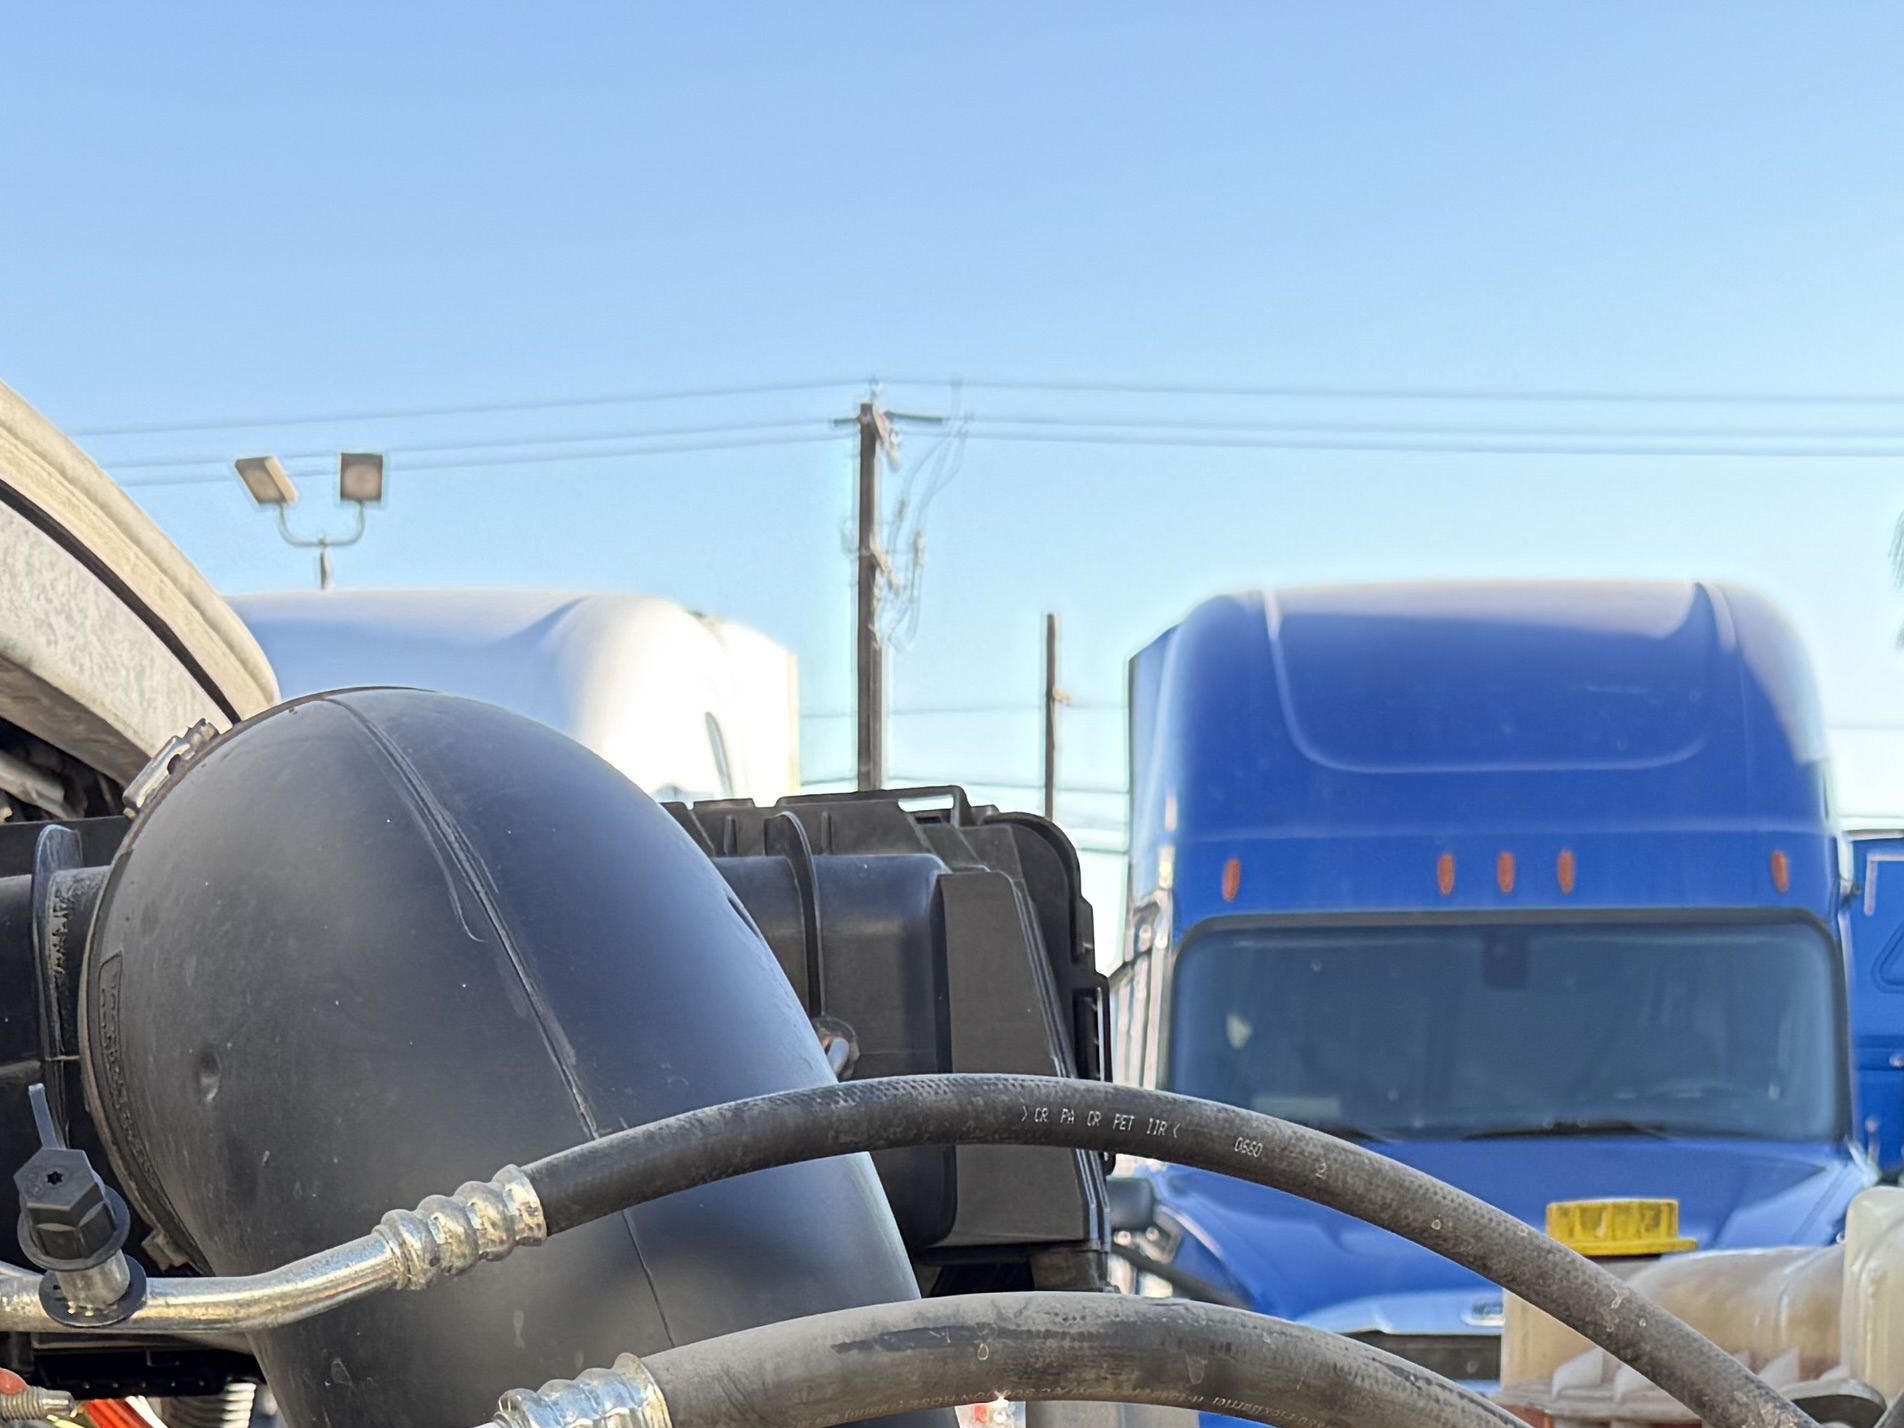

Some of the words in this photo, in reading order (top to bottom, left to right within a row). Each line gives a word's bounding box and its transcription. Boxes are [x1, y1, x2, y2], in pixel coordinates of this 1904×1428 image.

[1059, 1108, 1076, 1125] PA
[1086, 1110, 1102, 1128] CR
[1112, 1113, 1136, 1132] PET
